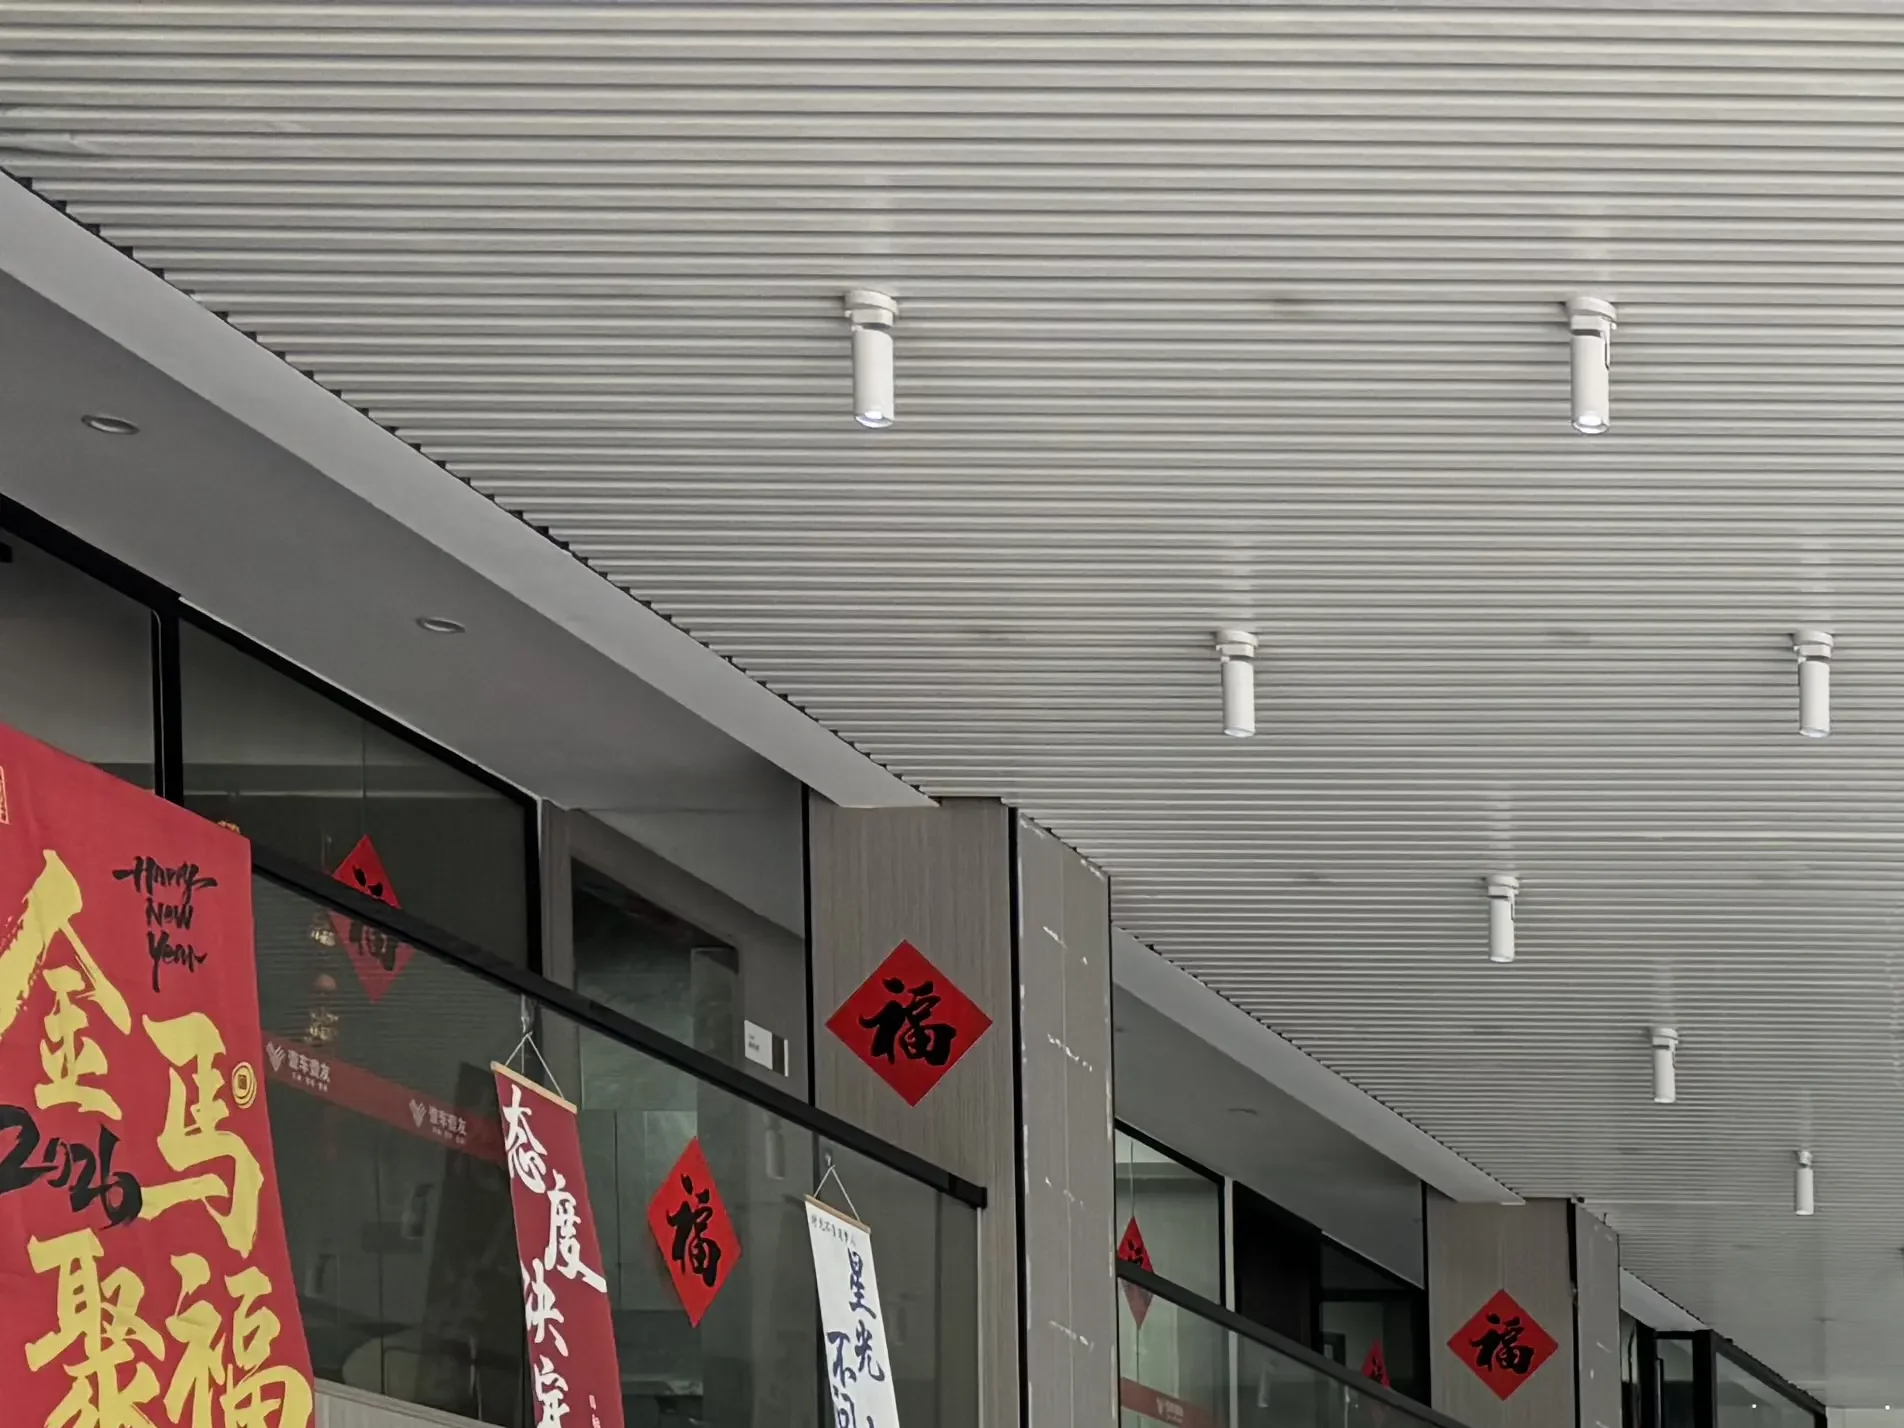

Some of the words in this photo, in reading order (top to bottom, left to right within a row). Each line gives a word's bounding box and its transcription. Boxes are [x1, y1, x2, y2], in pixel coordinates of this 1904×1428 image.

[145, 897, 193, 930] New
[147, 929, 208, 993] Year
[856, 977, 958, 1067] 福
[0, 1104, 142, 1229] 2026
[666, 1175, 722, 1289] 福
[1469, 1312, 1535, 1376] 福
